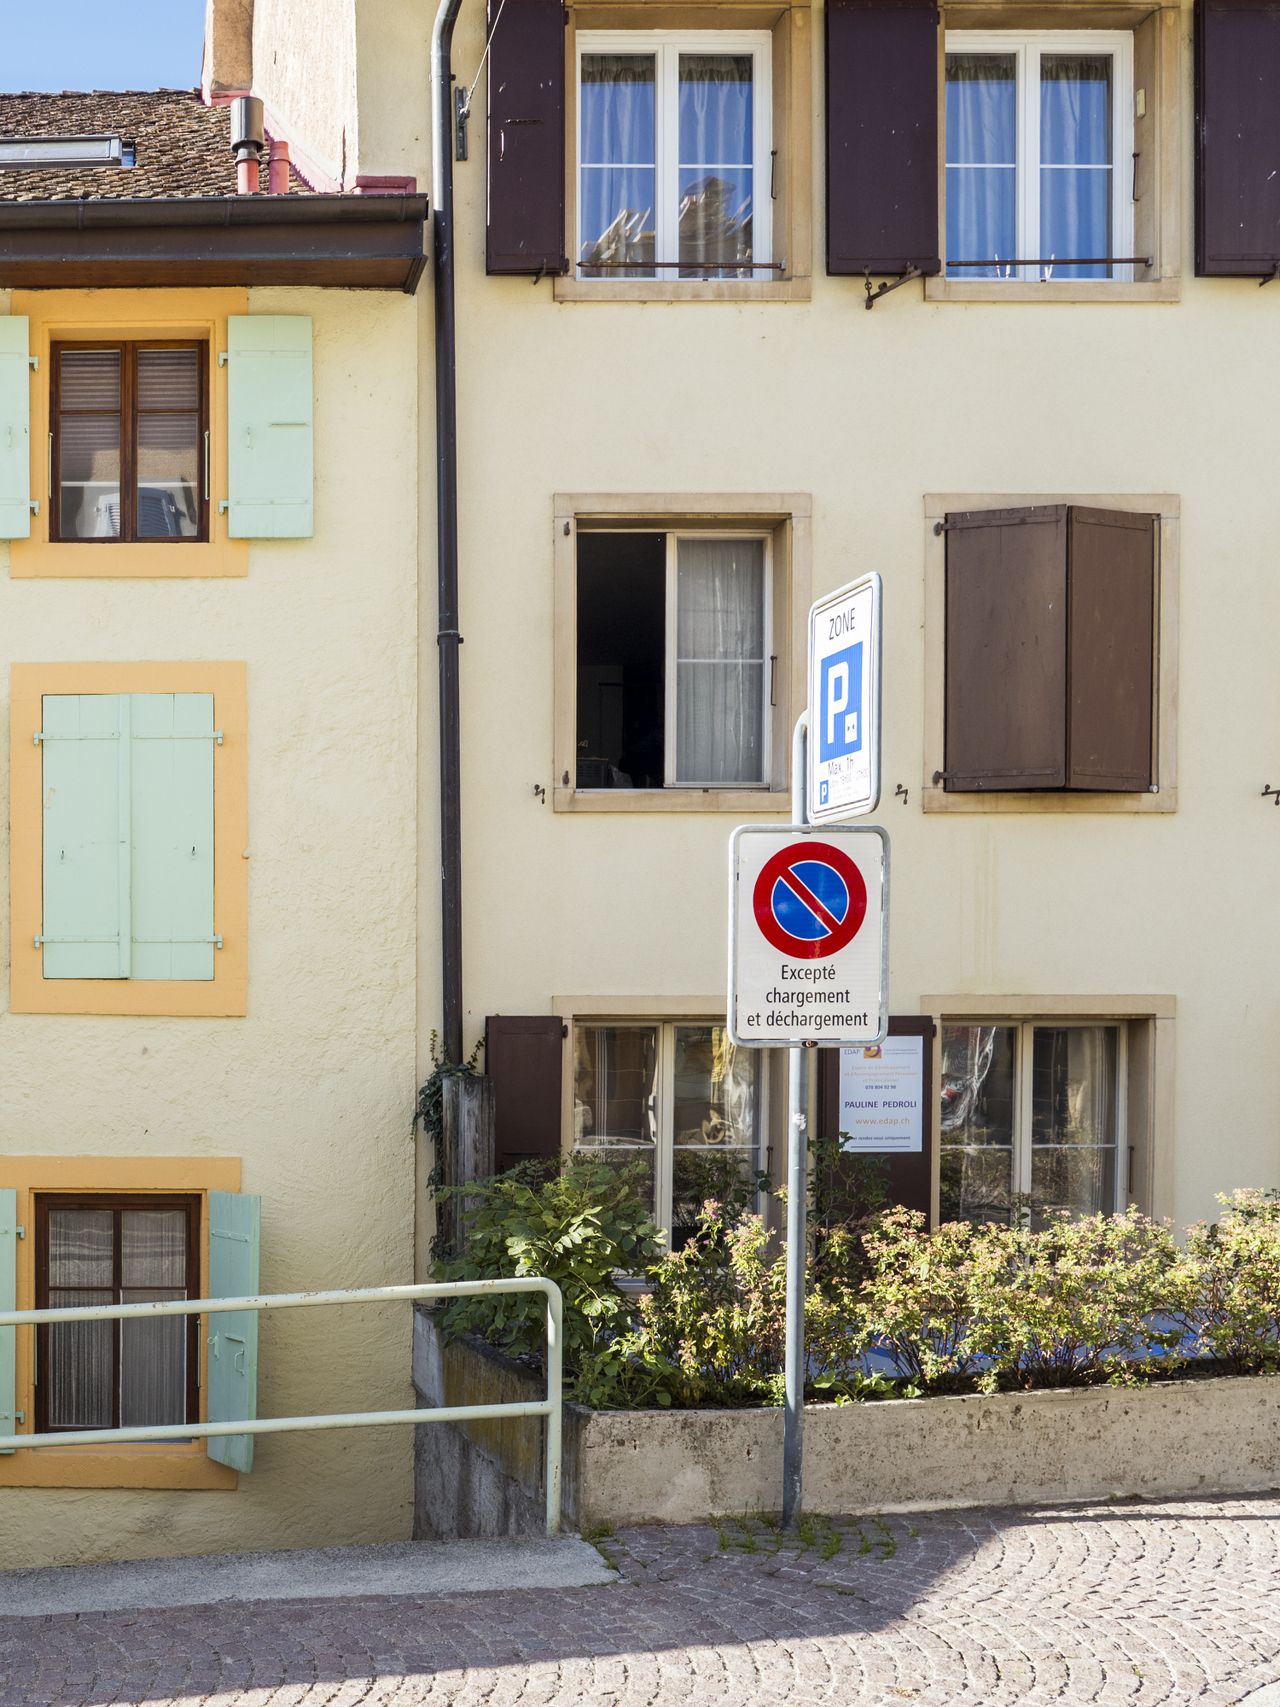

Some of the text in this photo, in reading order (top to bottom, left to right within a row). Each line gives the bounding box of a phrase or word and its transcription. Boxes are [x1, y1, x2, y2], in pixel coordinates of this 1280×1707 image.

[829, 607, 855, 640] ZONE
[846, 755, 854, 770] 1h
[781, 964, 836, 984] Excepté
[766, 987, 850, 1008] chargement
[747, 1010, 868, 1030] et déchargement
[855, 1117, 910, 1126] www.edap.ch
